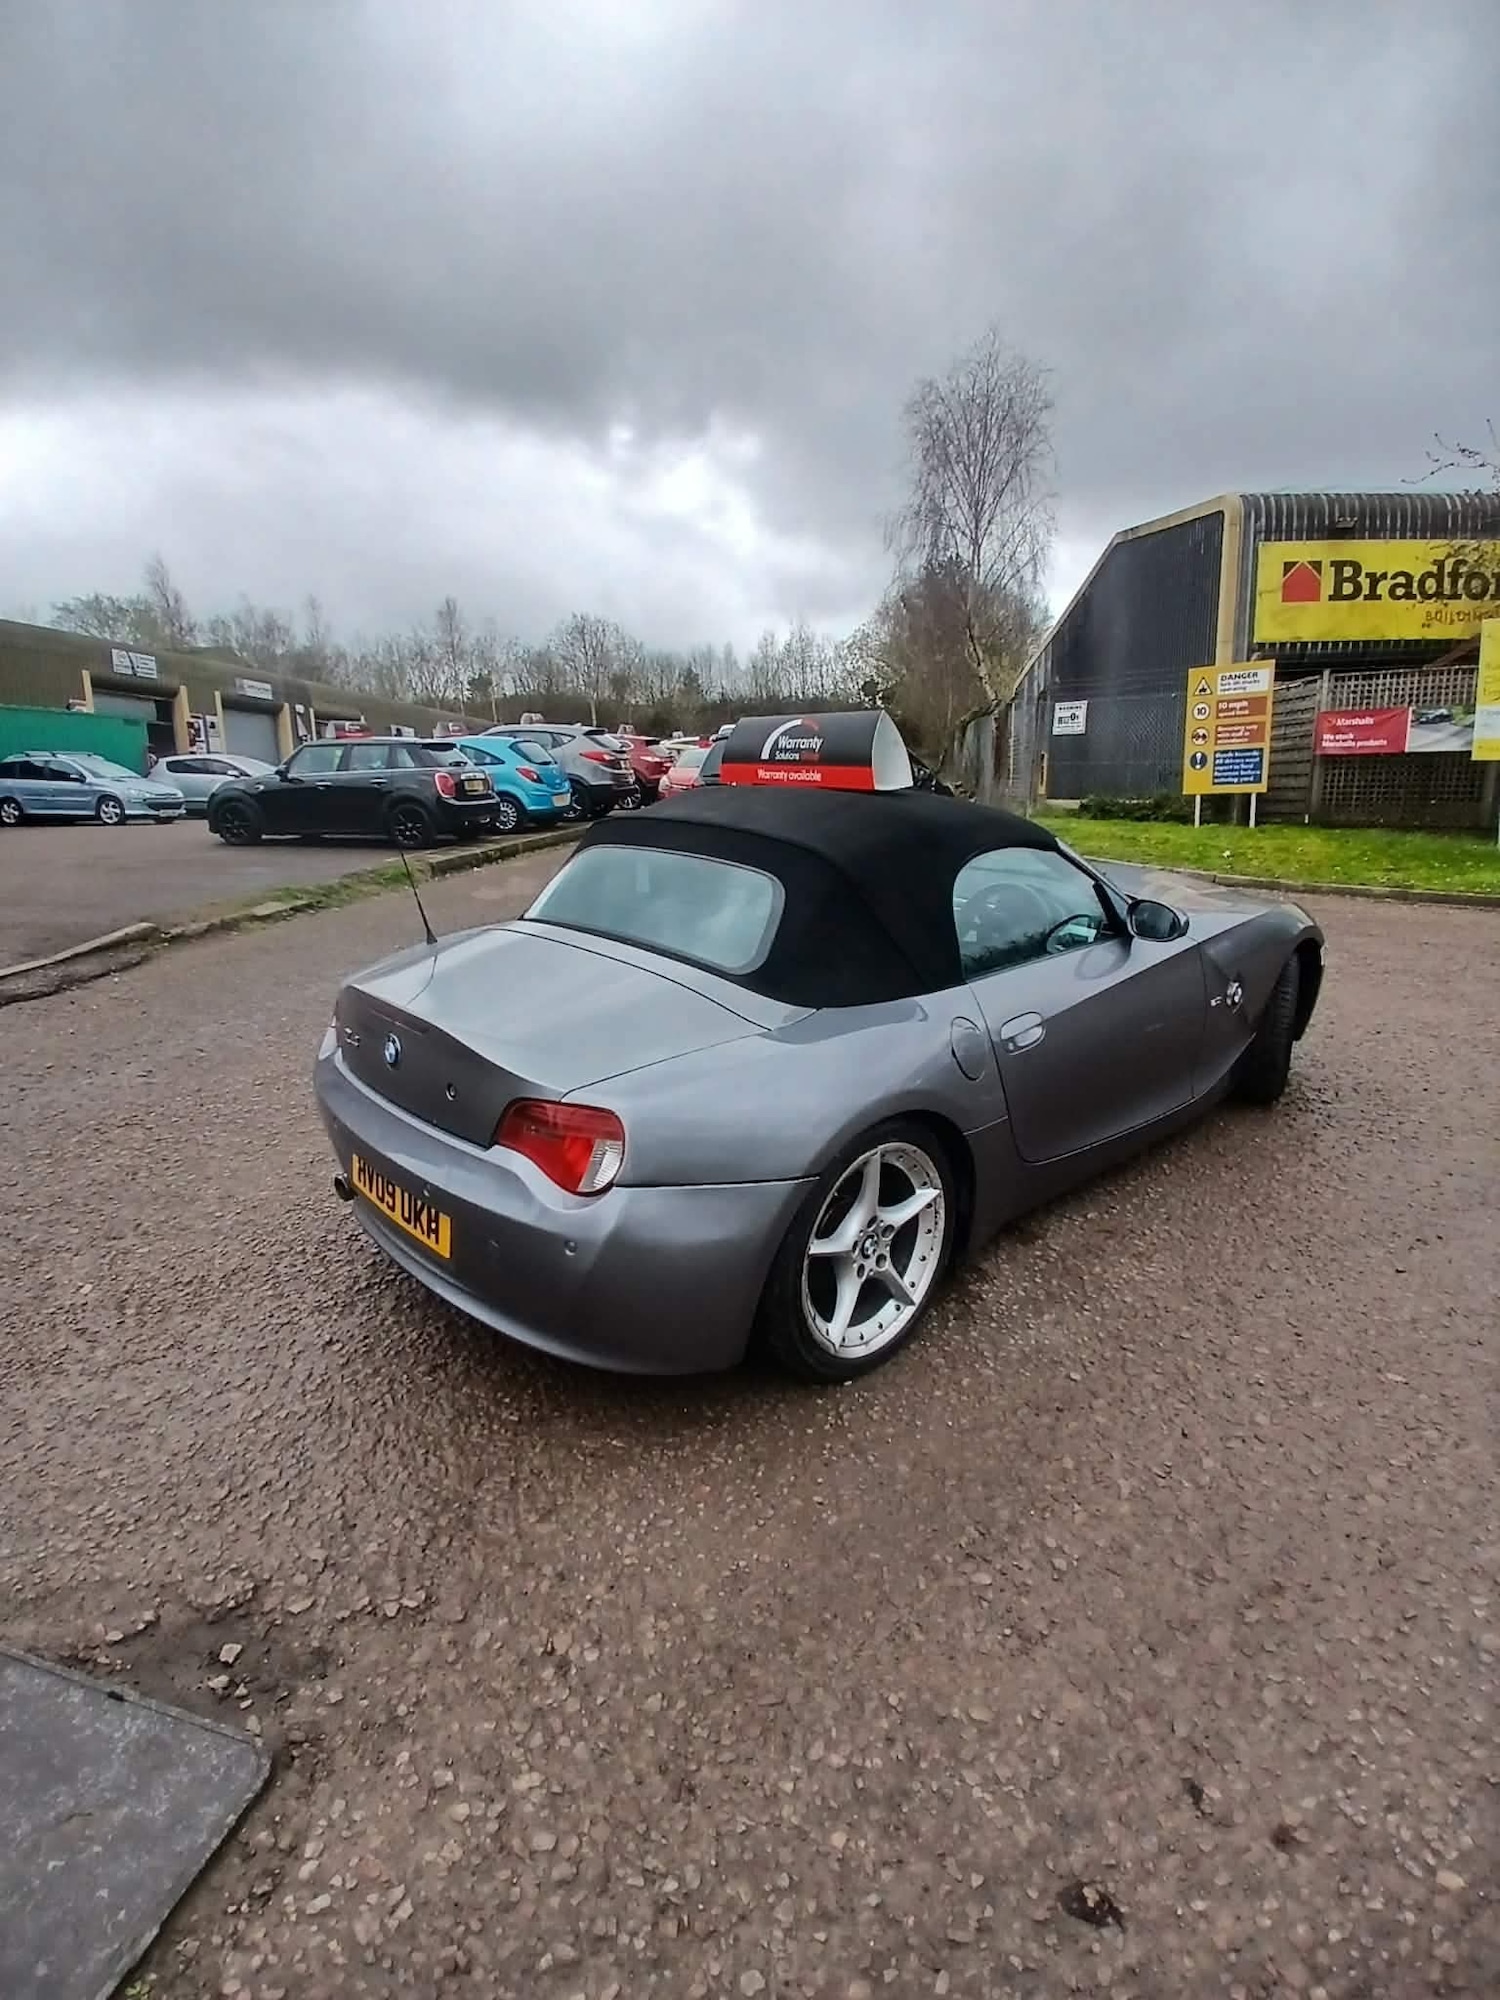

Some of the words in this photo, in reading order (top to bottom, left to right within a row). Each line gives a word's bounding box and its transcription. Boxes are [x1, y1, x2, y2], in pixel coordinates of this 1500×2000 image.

[1220, 671, 1258, 681] DANGER
[1197, 706, 1207, 716] 10
[1336, 716, 1375, 726] Marshalls
[778, 735, 824, 752] Warranty
[775, 751, 800, 760] Solutions
[757, 768, 788, 782] Warranty
[788, 769, 822, 782] available
[358, 1157, 396, 1214] HV09
